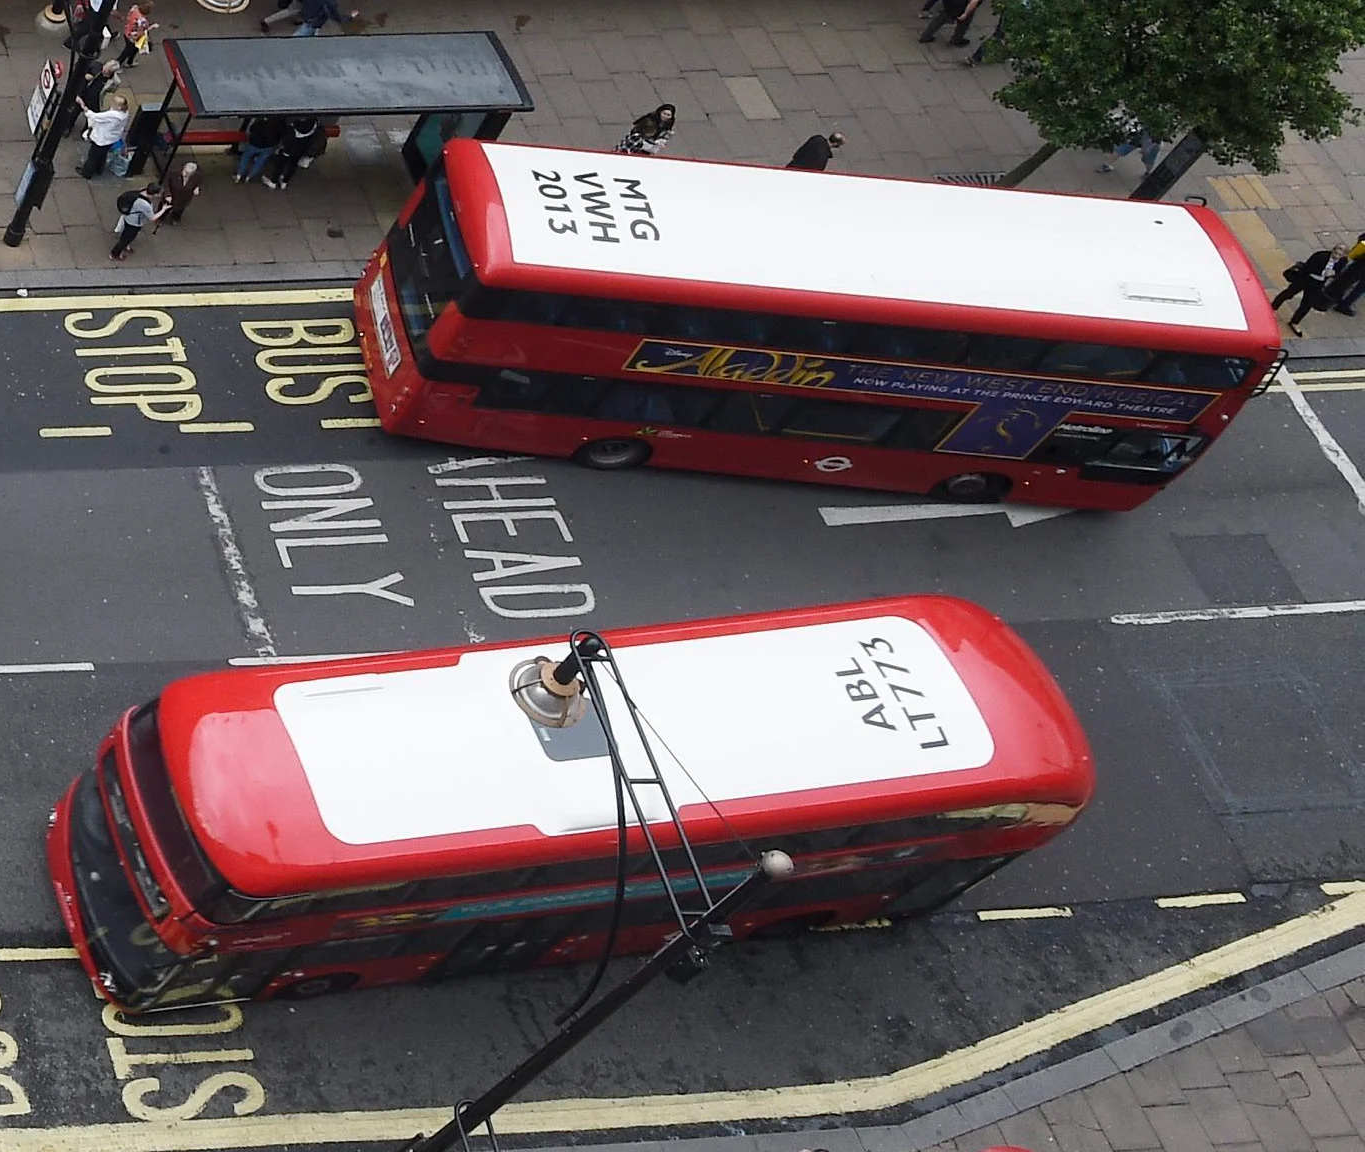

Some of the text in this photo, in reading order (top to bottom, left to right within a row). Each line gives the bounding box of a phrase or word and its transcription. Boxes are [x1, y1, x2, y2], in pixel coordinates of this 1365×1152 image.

[531, 169, 579, 235] 2013
[572, 171, 621, 243] VWH
[612, 177, 661, 242] MTG
[64, 309, 203, 422] STOP
[636, 347, 836, 389] Aladdin
[847, 363, 1200, 408] THE NEW WEST END MUSICAL
[853, 377, 1179, 415] NOW PLAYING AT THE PRINCE EDWARD THEATRE
[253, 464, 415, 606] ONLY
[834, 657, 898, 731] ABL
[857, 637, 950, 749] LT773
[102, 998, 267, 1122] STO
